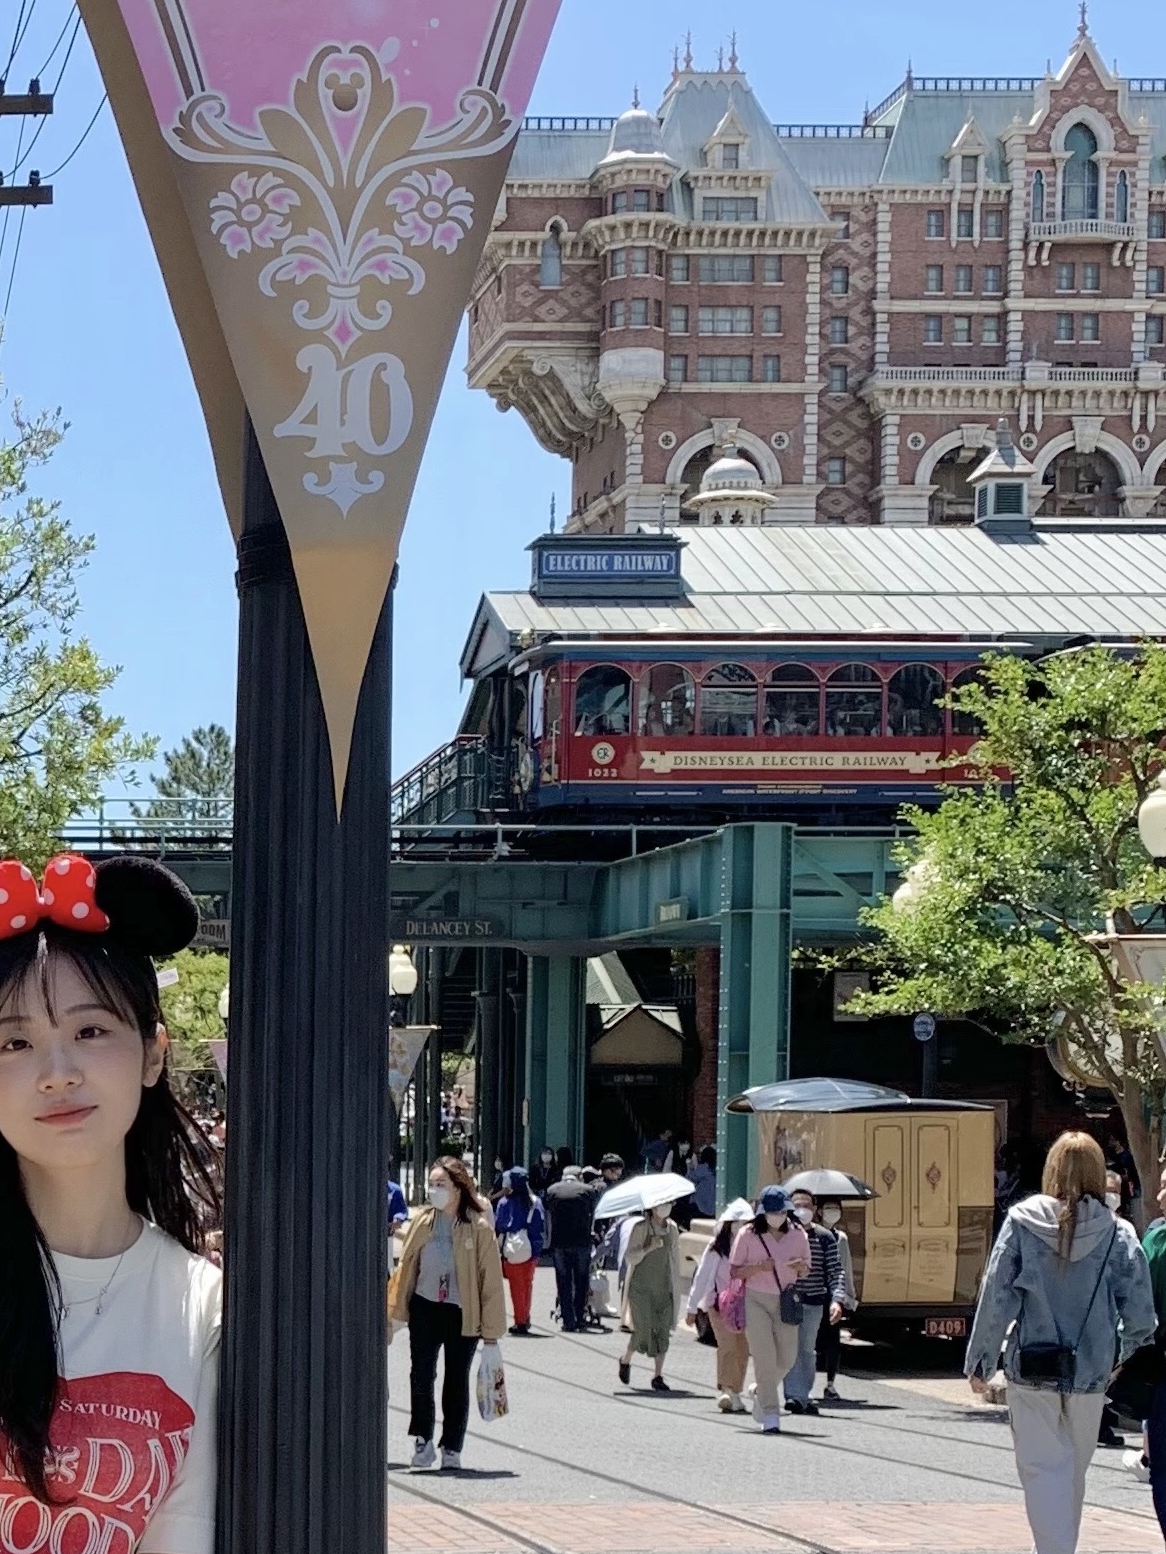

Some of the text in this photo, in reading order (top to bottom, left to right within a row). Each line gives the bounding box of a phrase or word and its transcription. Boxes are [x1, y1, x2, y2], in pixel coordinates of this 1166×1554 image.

[273, 343, 414, 458] 40
[548, 554, 670, 571] ELECTRIC RAILWAY
[673, 755, 907, 767] DISNEYSEA ELECTRIC RAILWAY
[406, 919, 493, 936] DELANCEY ST.
[58, 1399, 163, 1431] SATURDAY
